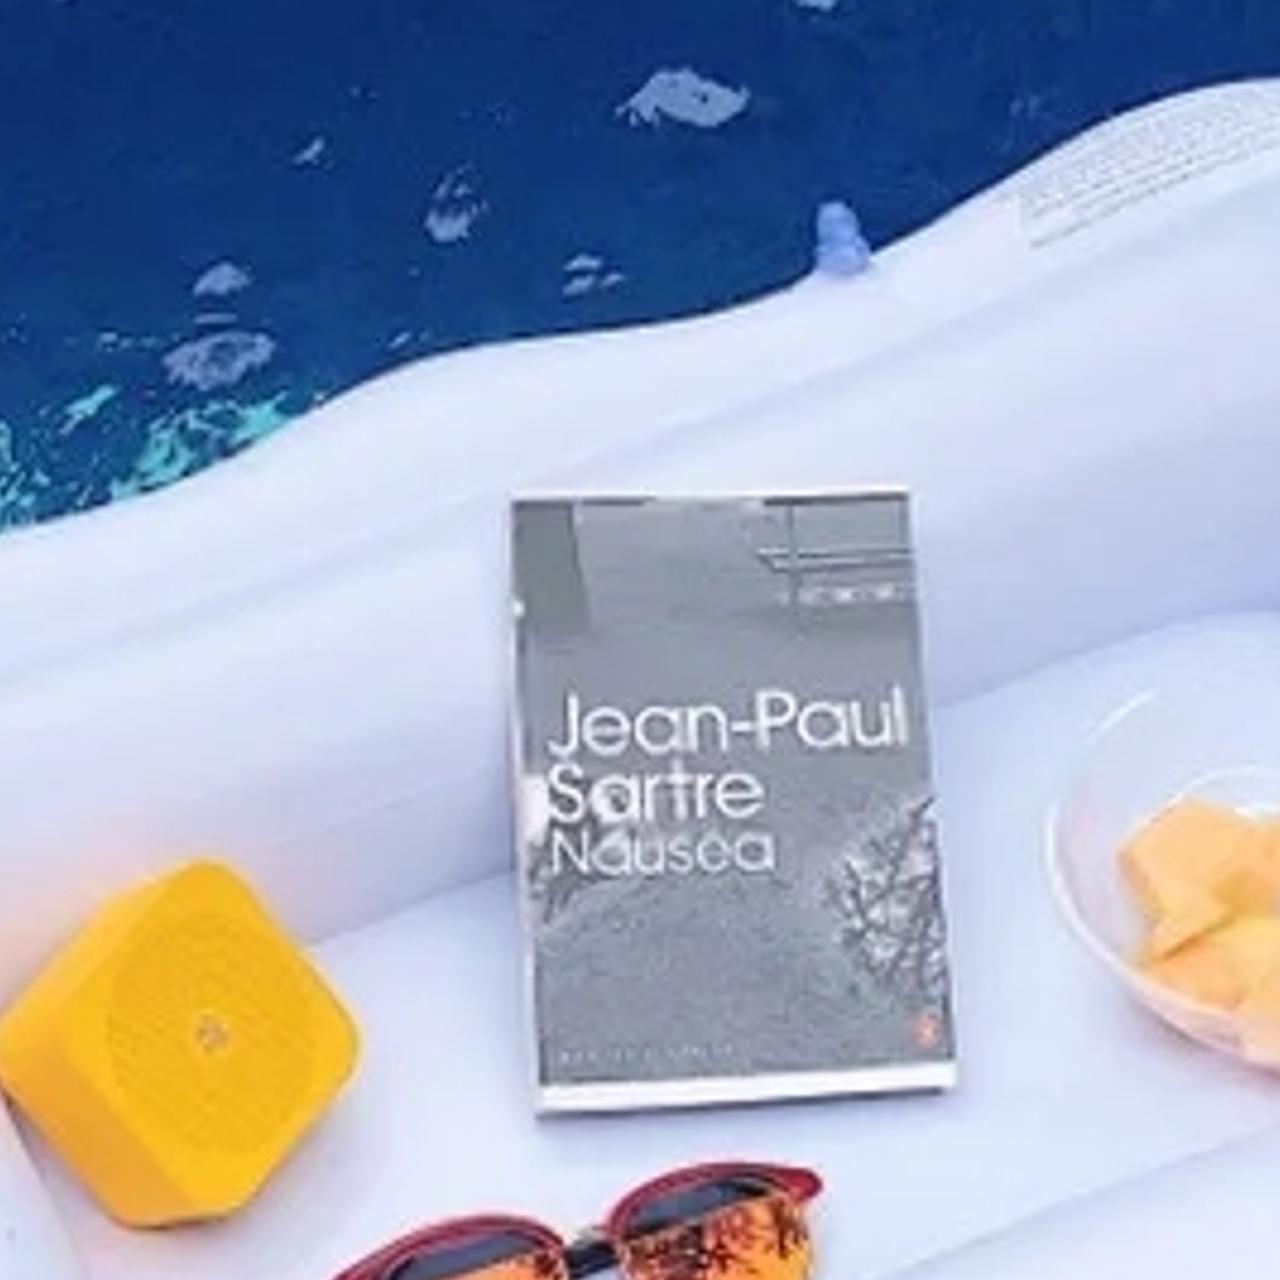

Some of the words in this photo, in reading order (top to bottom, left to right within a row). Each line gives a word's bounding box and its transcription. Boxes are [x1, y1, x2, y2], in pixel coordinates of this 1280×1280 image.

[548, 684, 909, 757] Jean-Paul
[548, 758, 766, 825] Sartre
[551, 828, 776, 875] Nausea
